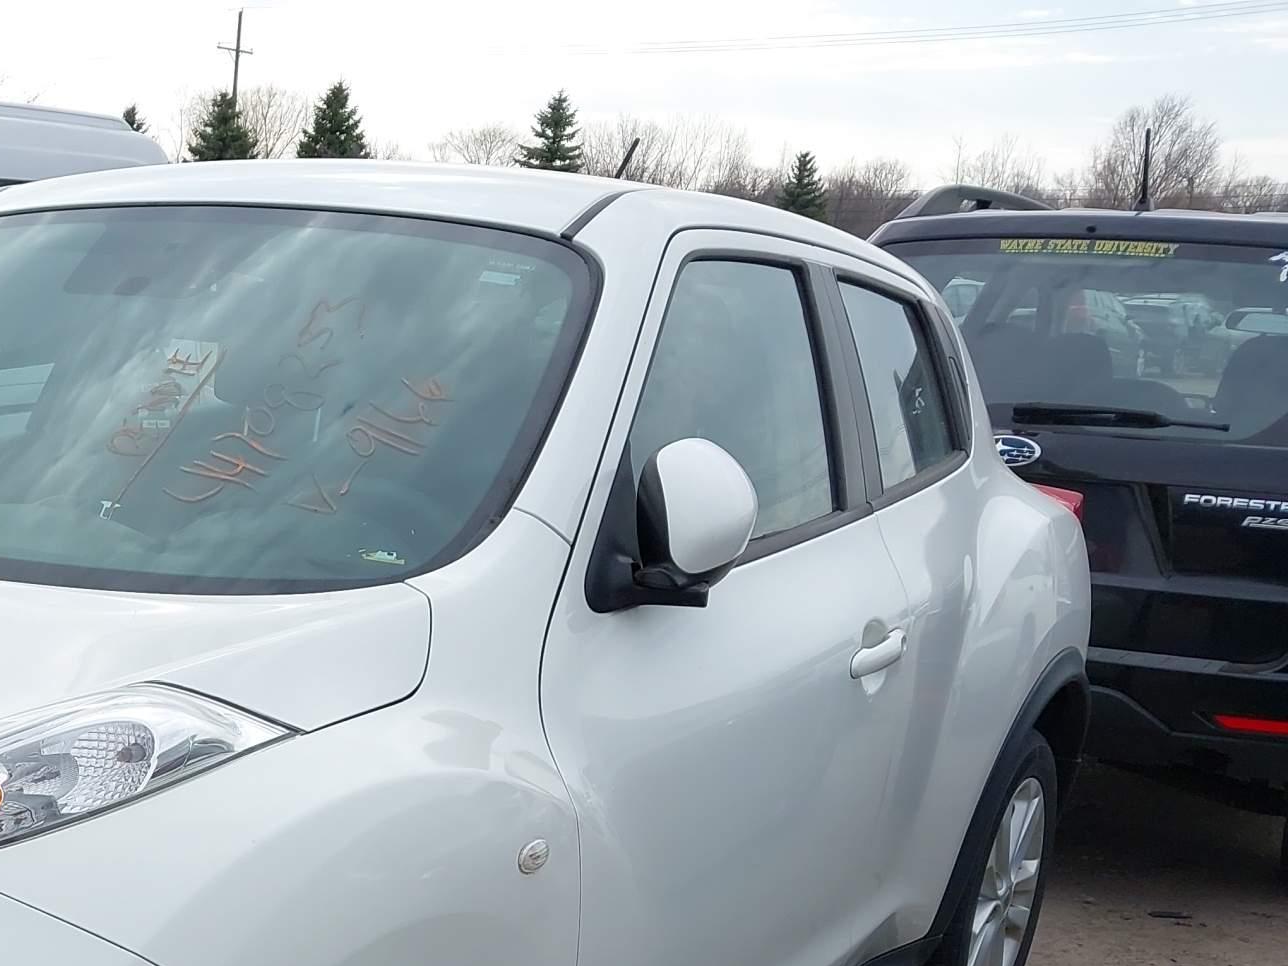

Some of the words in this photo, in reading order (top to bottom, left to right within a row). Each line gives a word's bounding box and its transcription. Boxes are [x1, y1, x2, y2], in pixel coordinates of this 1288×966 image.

[999, 239, 1044, 250] WAYNE
[1047, 239, 1091, 251] STATE
[1094, 240, 1180, 255] UNIVERSITY
